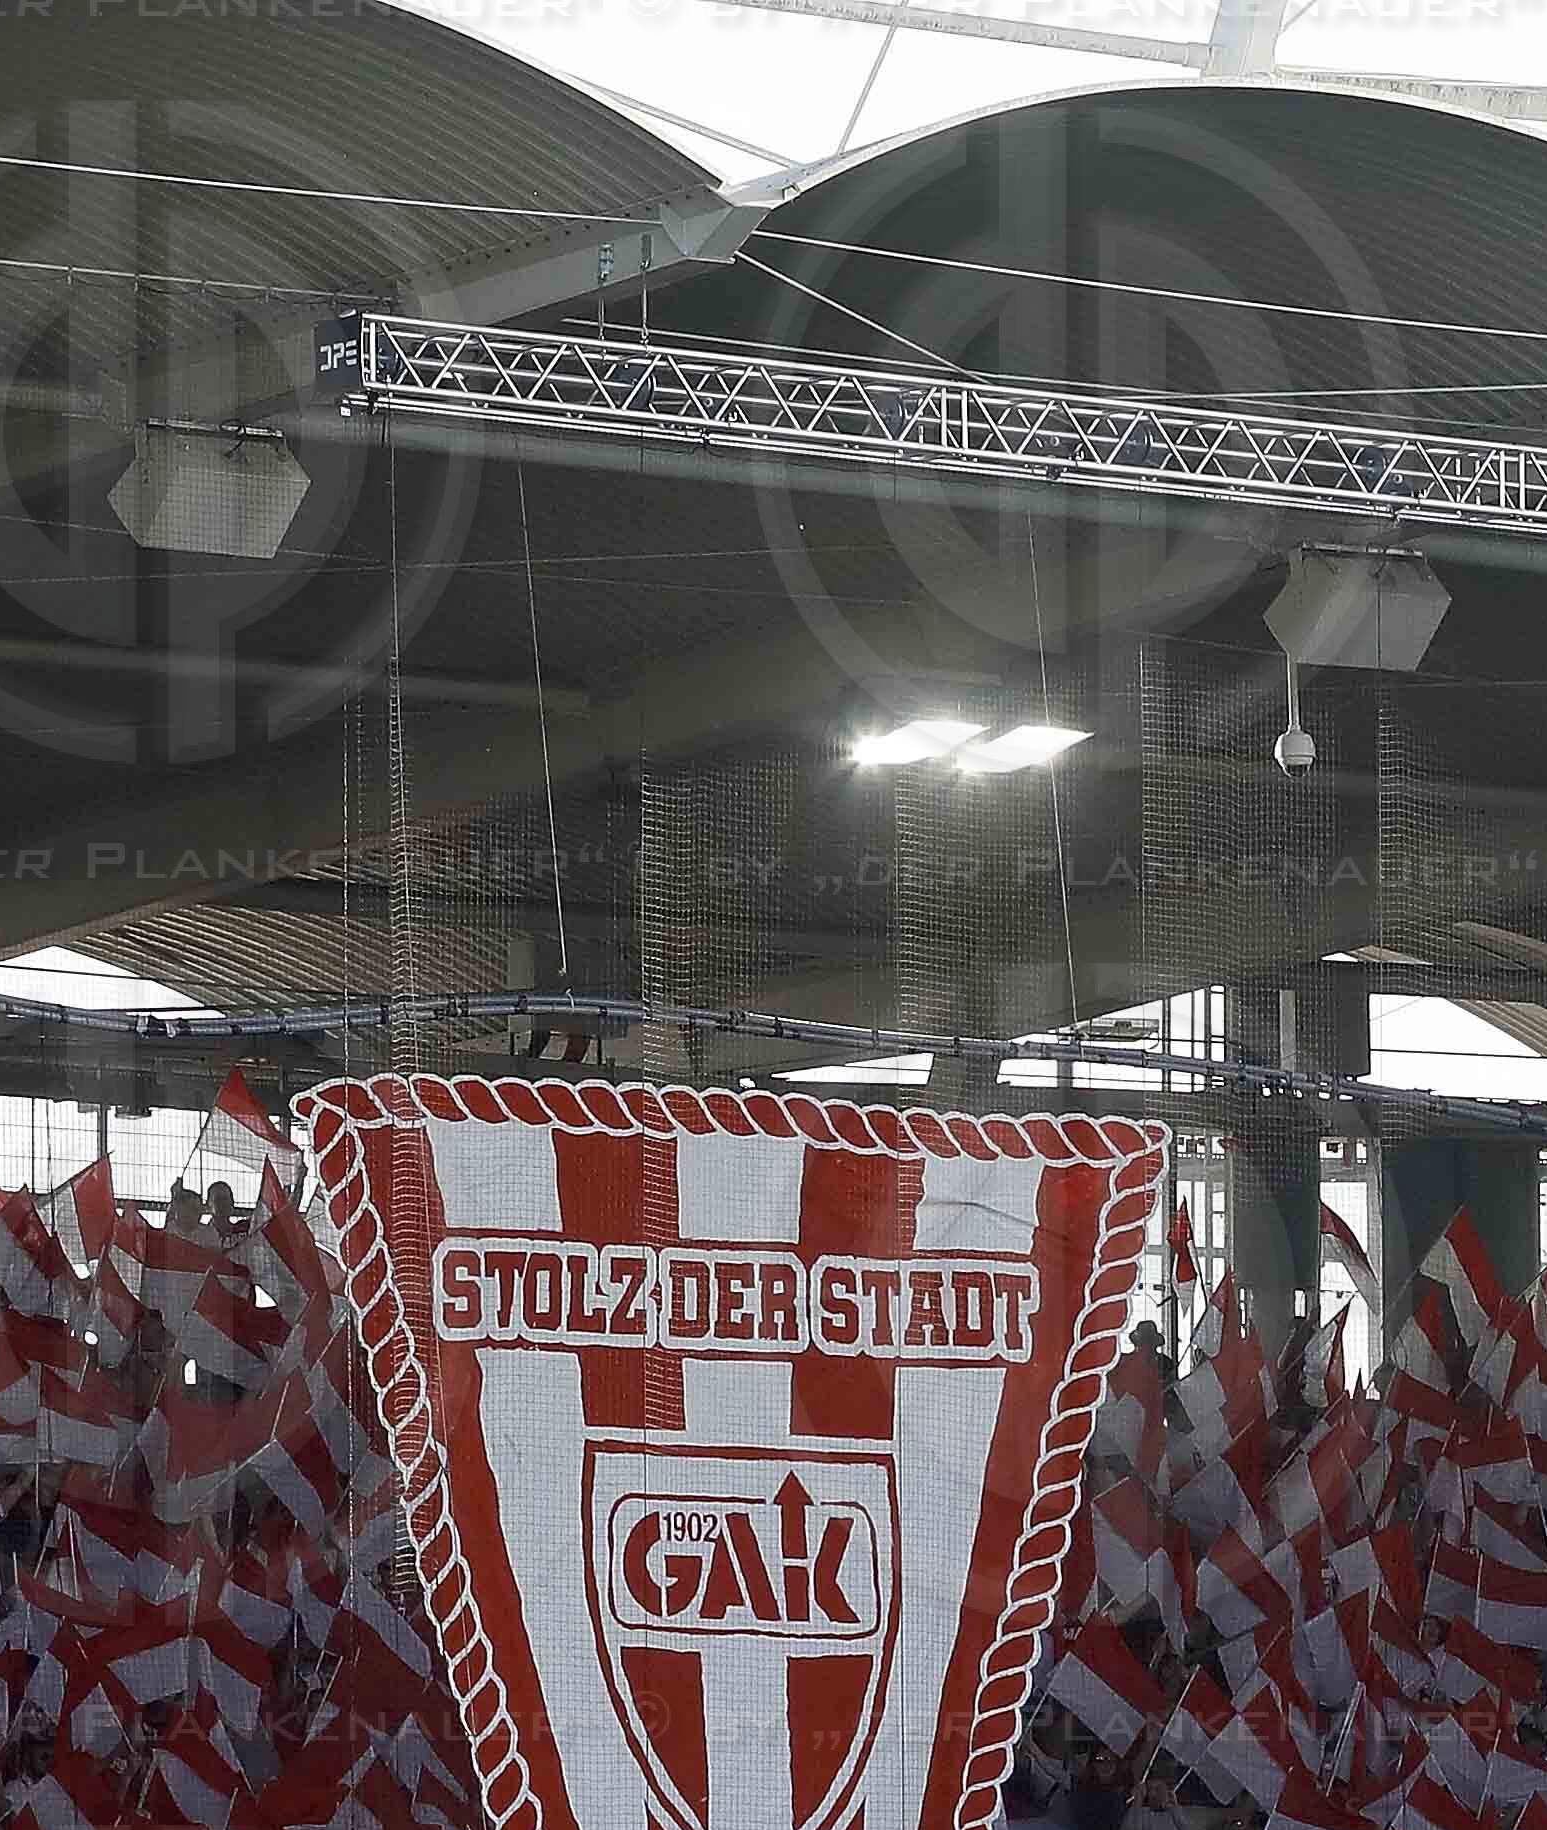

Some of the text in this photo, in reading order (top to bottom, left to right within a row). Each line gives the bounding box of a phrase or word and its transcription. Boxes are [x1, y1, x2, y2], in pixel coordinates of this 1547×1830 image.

[440, 1246, 1034, 1354] STOLZ DER STADT
[621, 1490, 862, 1624] GAK
[661, 1509, 720, 1545] 1902
